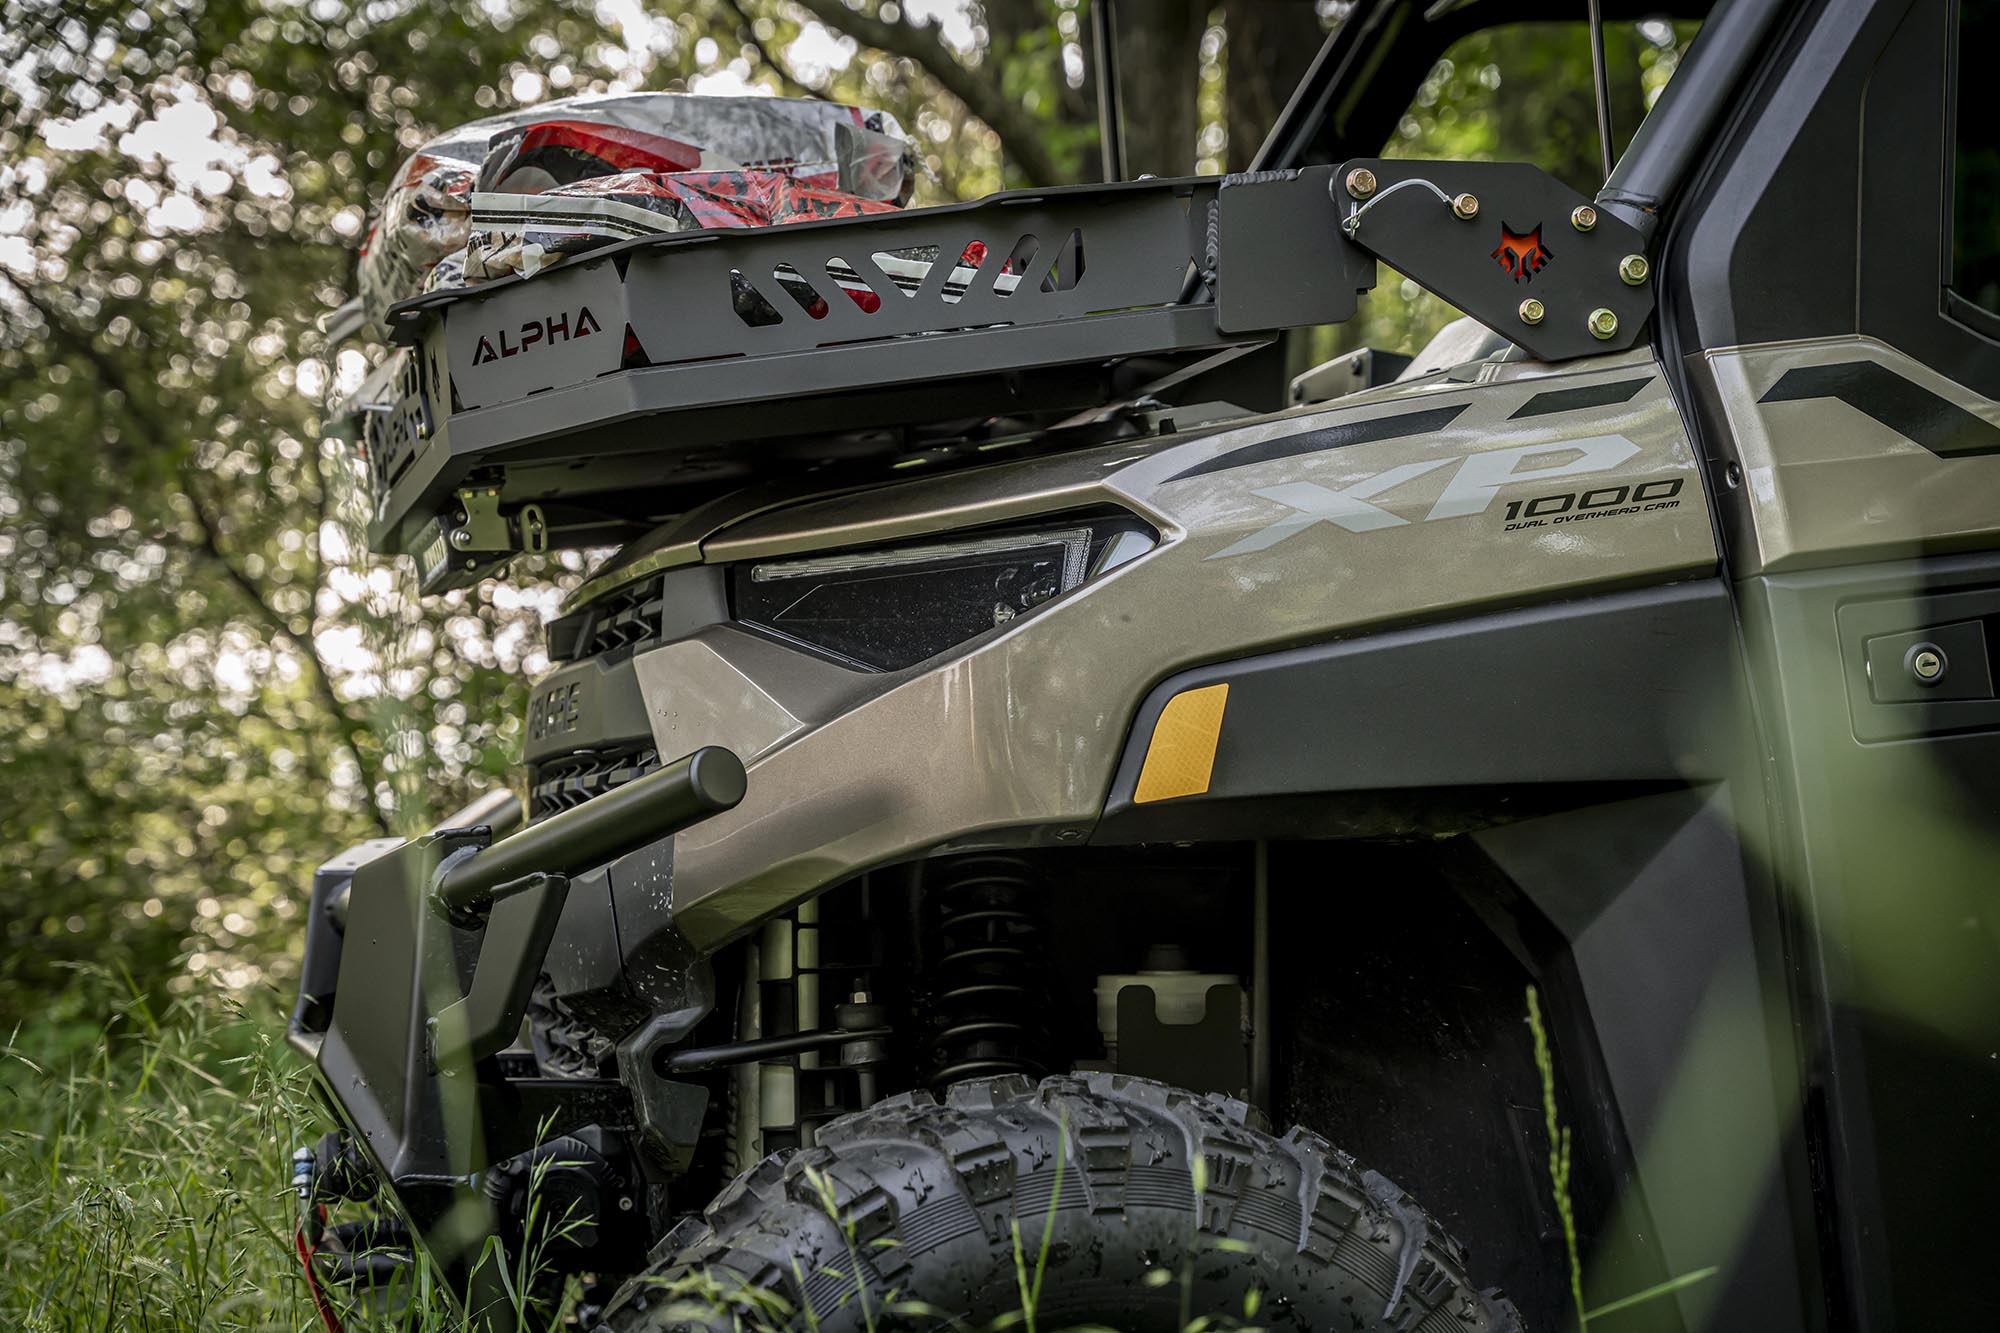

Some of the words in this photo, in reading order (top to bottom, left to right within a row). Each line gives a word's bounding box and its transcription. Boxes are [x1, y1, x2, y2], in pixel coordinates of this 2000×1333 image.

[472, 306, 602, 367] ALPHA
[1202, 433, 1642, 561] XP
[1504, 477, 1684, 521] 1000
[1504, 519, 1548, 532] DUAL
[1552, 506, 1641, 525] OVERHEAD
[1643, 500, 1681, 512] CAM
